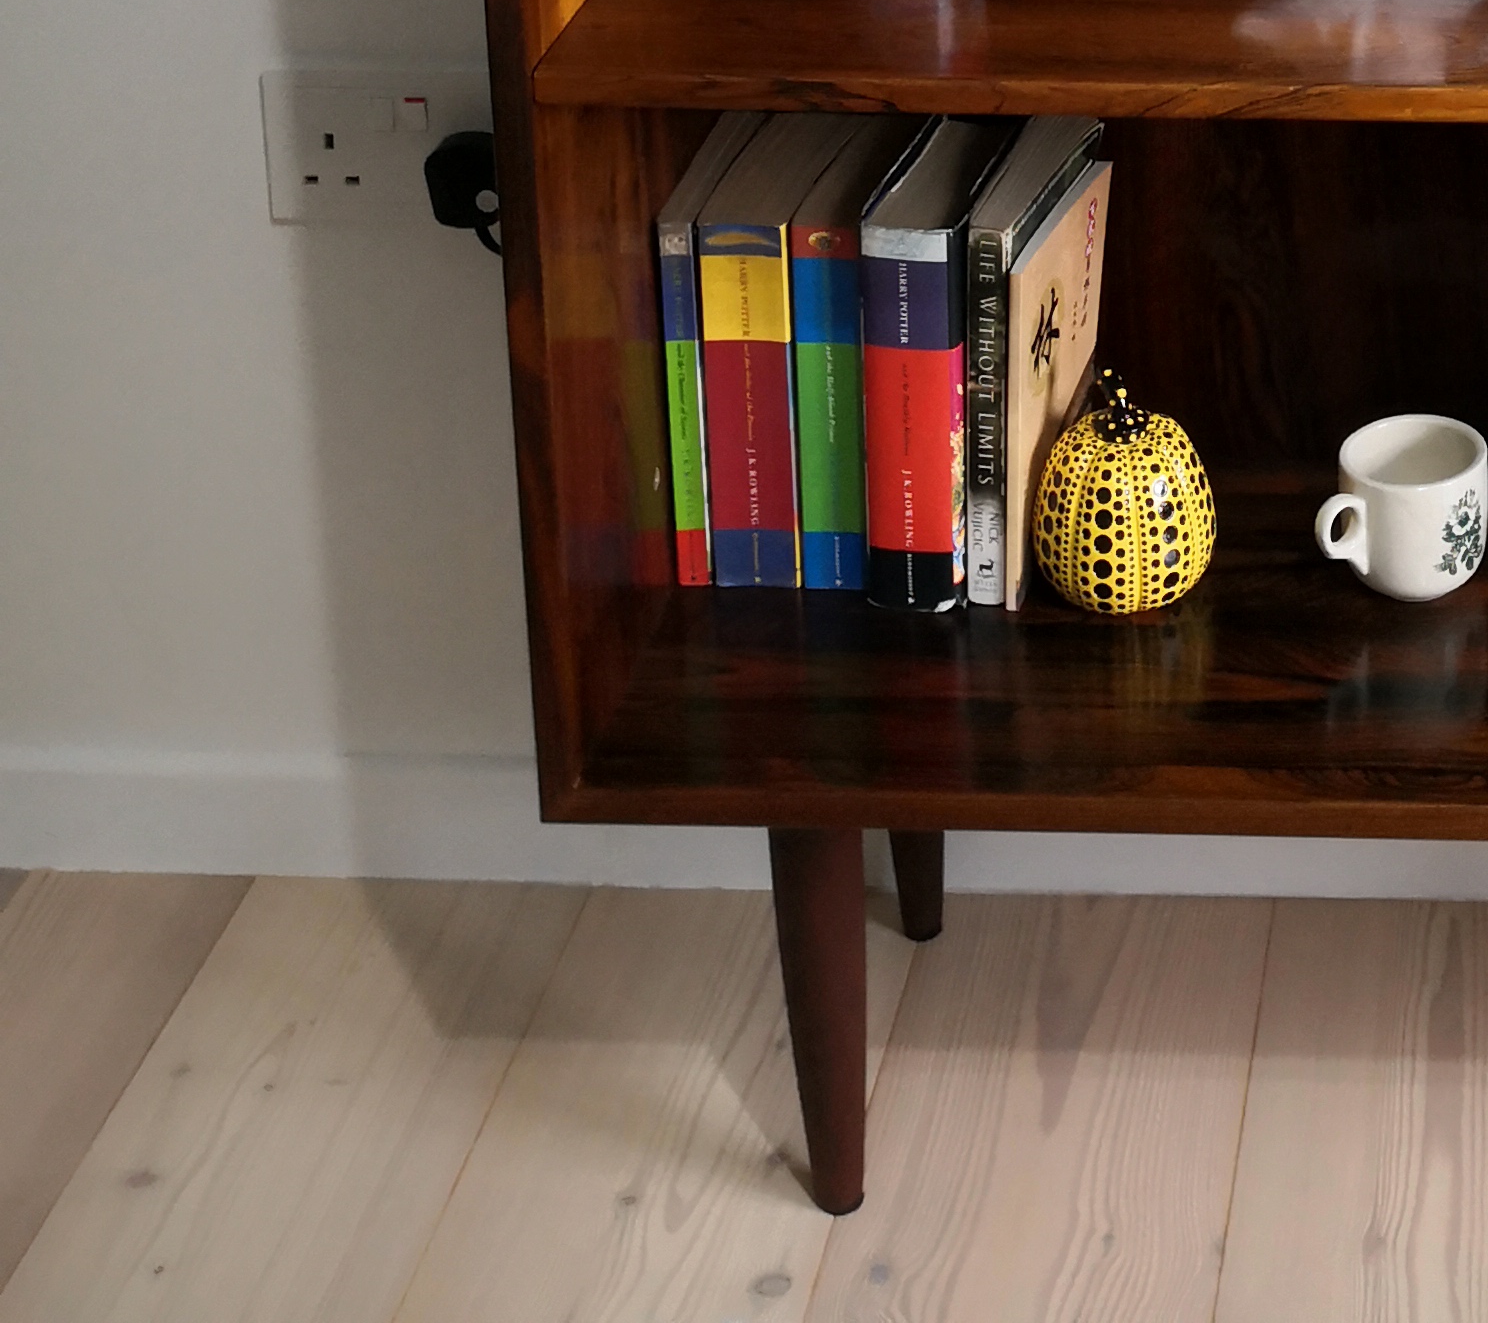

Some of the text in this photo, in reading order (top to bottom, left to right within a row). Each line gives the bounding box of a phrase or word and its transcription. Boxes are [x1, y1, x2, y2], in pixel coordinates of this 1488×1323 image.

[899, 262, 909, 344] HARRY POTTER
[977, 240, 998, 486] LIFE WITHOUT LIMITS
[971, 502, 984, 552] VUJICIC
[988, 511, 1000, 544] NICK
